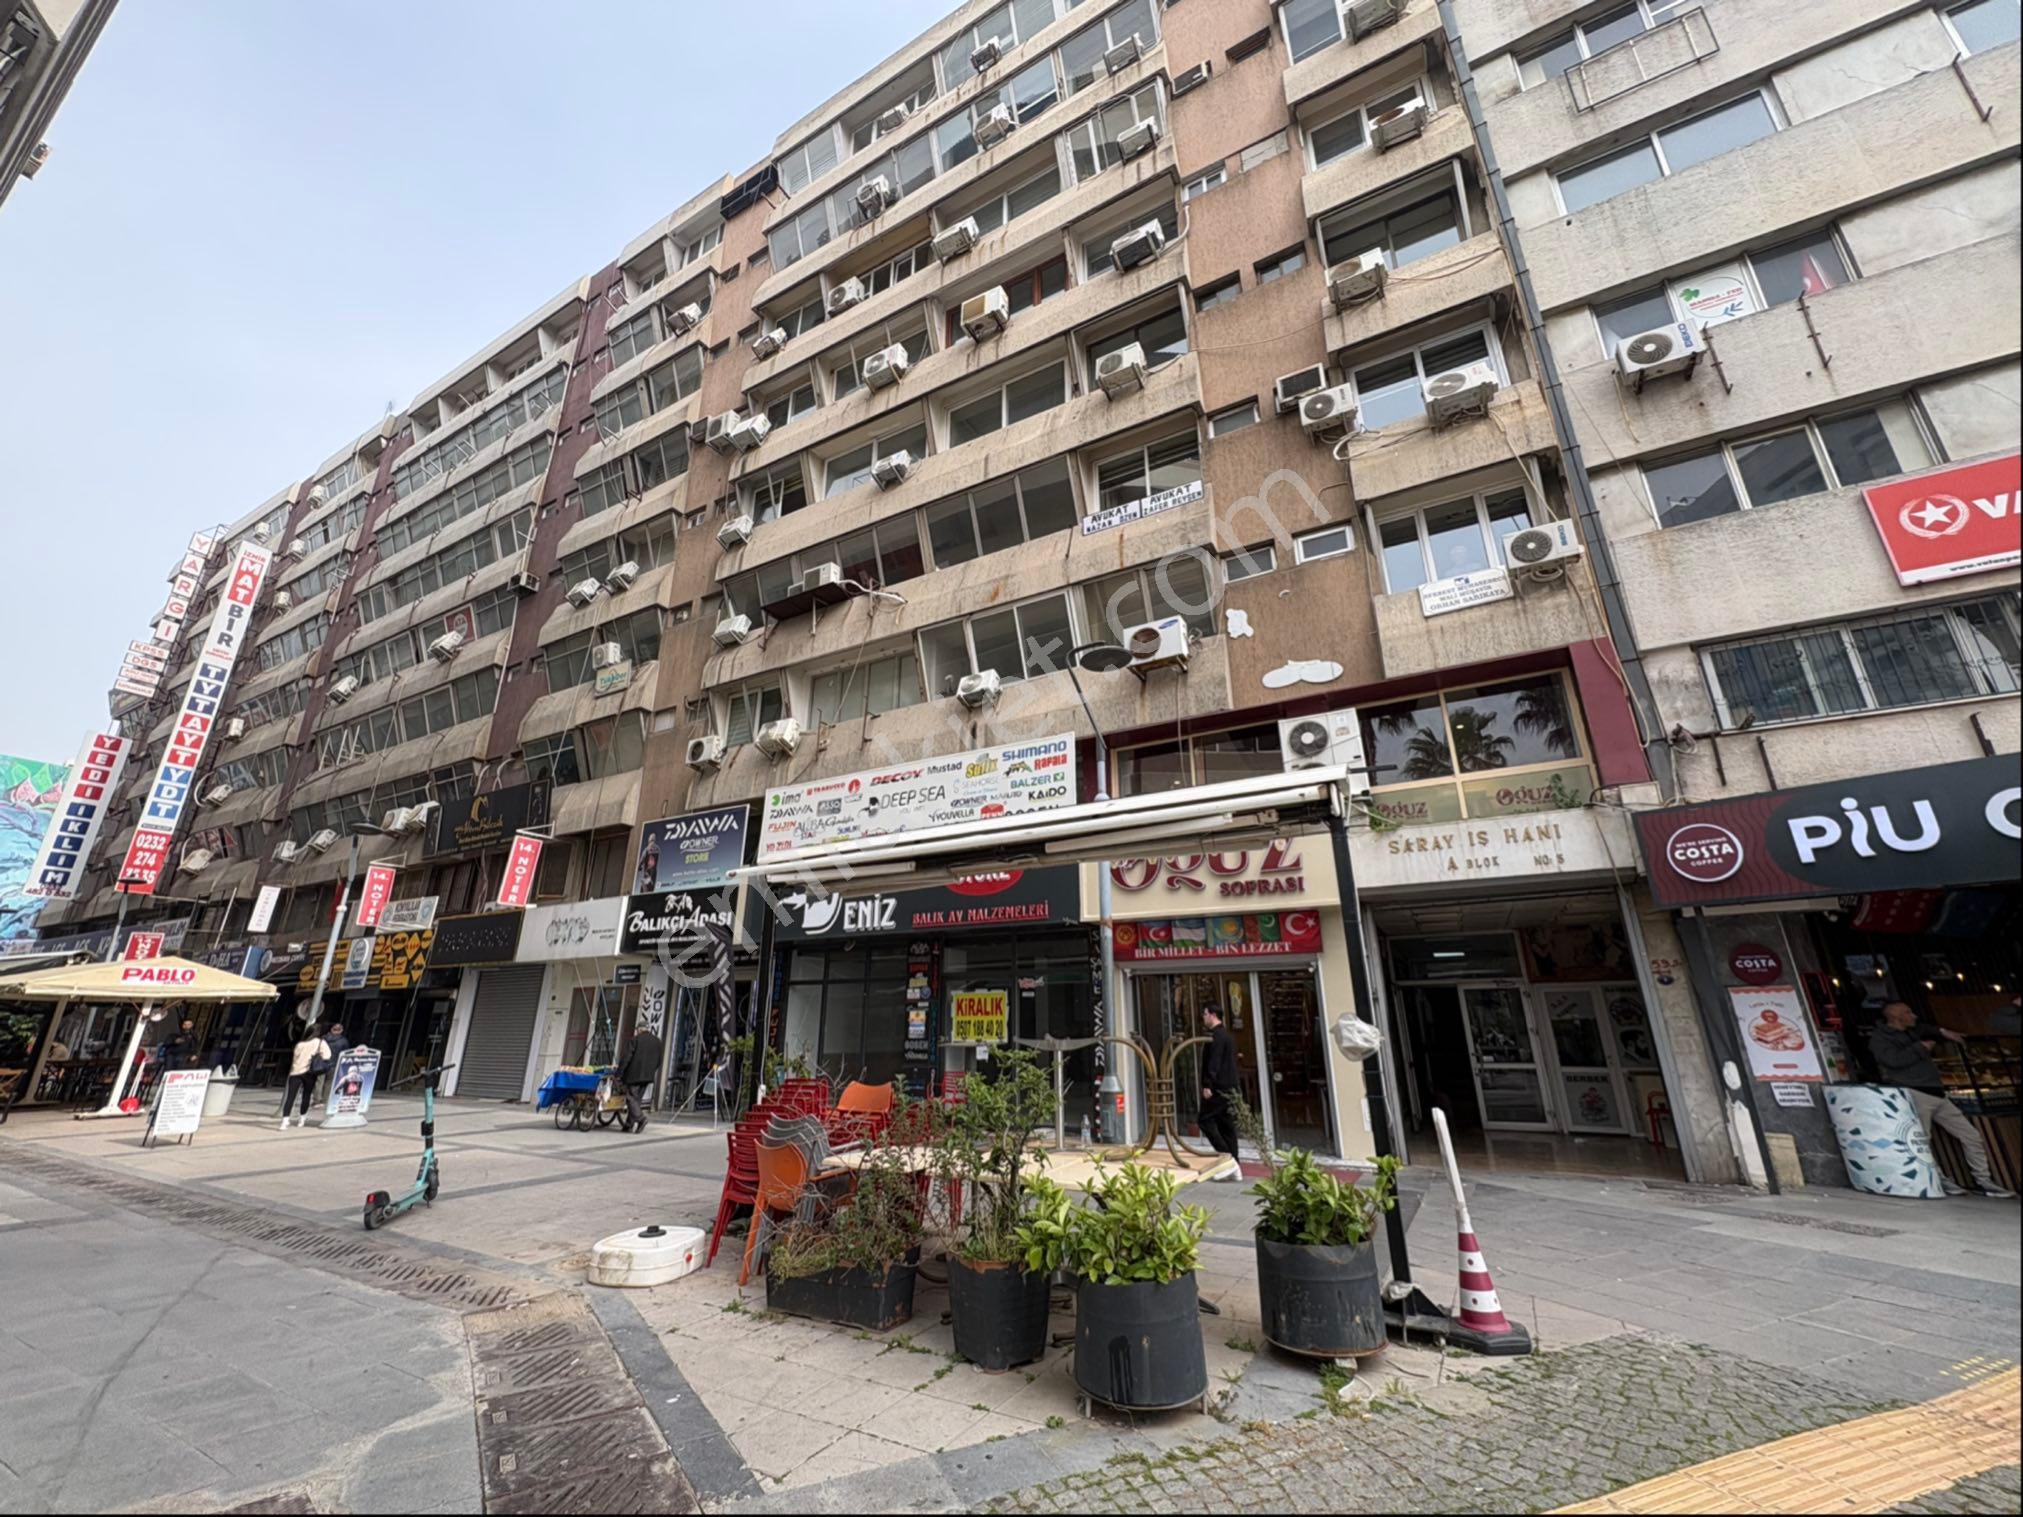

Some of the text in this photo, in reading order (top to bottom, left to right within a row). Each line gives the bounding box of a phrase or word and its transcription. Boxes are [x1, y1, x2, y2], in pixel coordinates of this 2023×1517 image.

[1150, 483, 1192, 506] AVUKAT
[1090, 504, 1130, 524] AVUKAT
[235, 558, 263, 602] MAT
[194, 666, 229, 714] TYT
[175, 716, 204, 764] AYT
[1002, 740, 1068, 762] SHIMANO
[869, 768, 925, 787] DECOY
[927, 761, 963, 775] Mustad
[1010, 774, 1052, 790] BALZER
[156, 768, 186, 817] YDT
[881, 789, 918, 809] DEEP
[918, 785, 946, 804] SEA
[135, 833, 167, 850] 0232
[1388, 834, 1454, 855] SARAY
[132, 851, 157, 866] 274
[1674, 843, 1735, 861] COSTA
[1690, 857, 1724, 867] COFFEE
[1447, 856, 1459, 871] A
[1466, 855, 1500, 870] BLOK
[508, 856, 529, 904] NOTER
[366, 884, 384, 924] NOTER
[912, 899, 1050, 927] BALIK AV MALZEMELERİ
[628, 910, 685, 934] BALIKÇI
[1158, 944, 1205, 958] MİLLET
[1242, 940, 1292, 953] LEZZET
[1735, 958, 1777, 968] COSTA
[122, 966, 196, 983] PABLO
